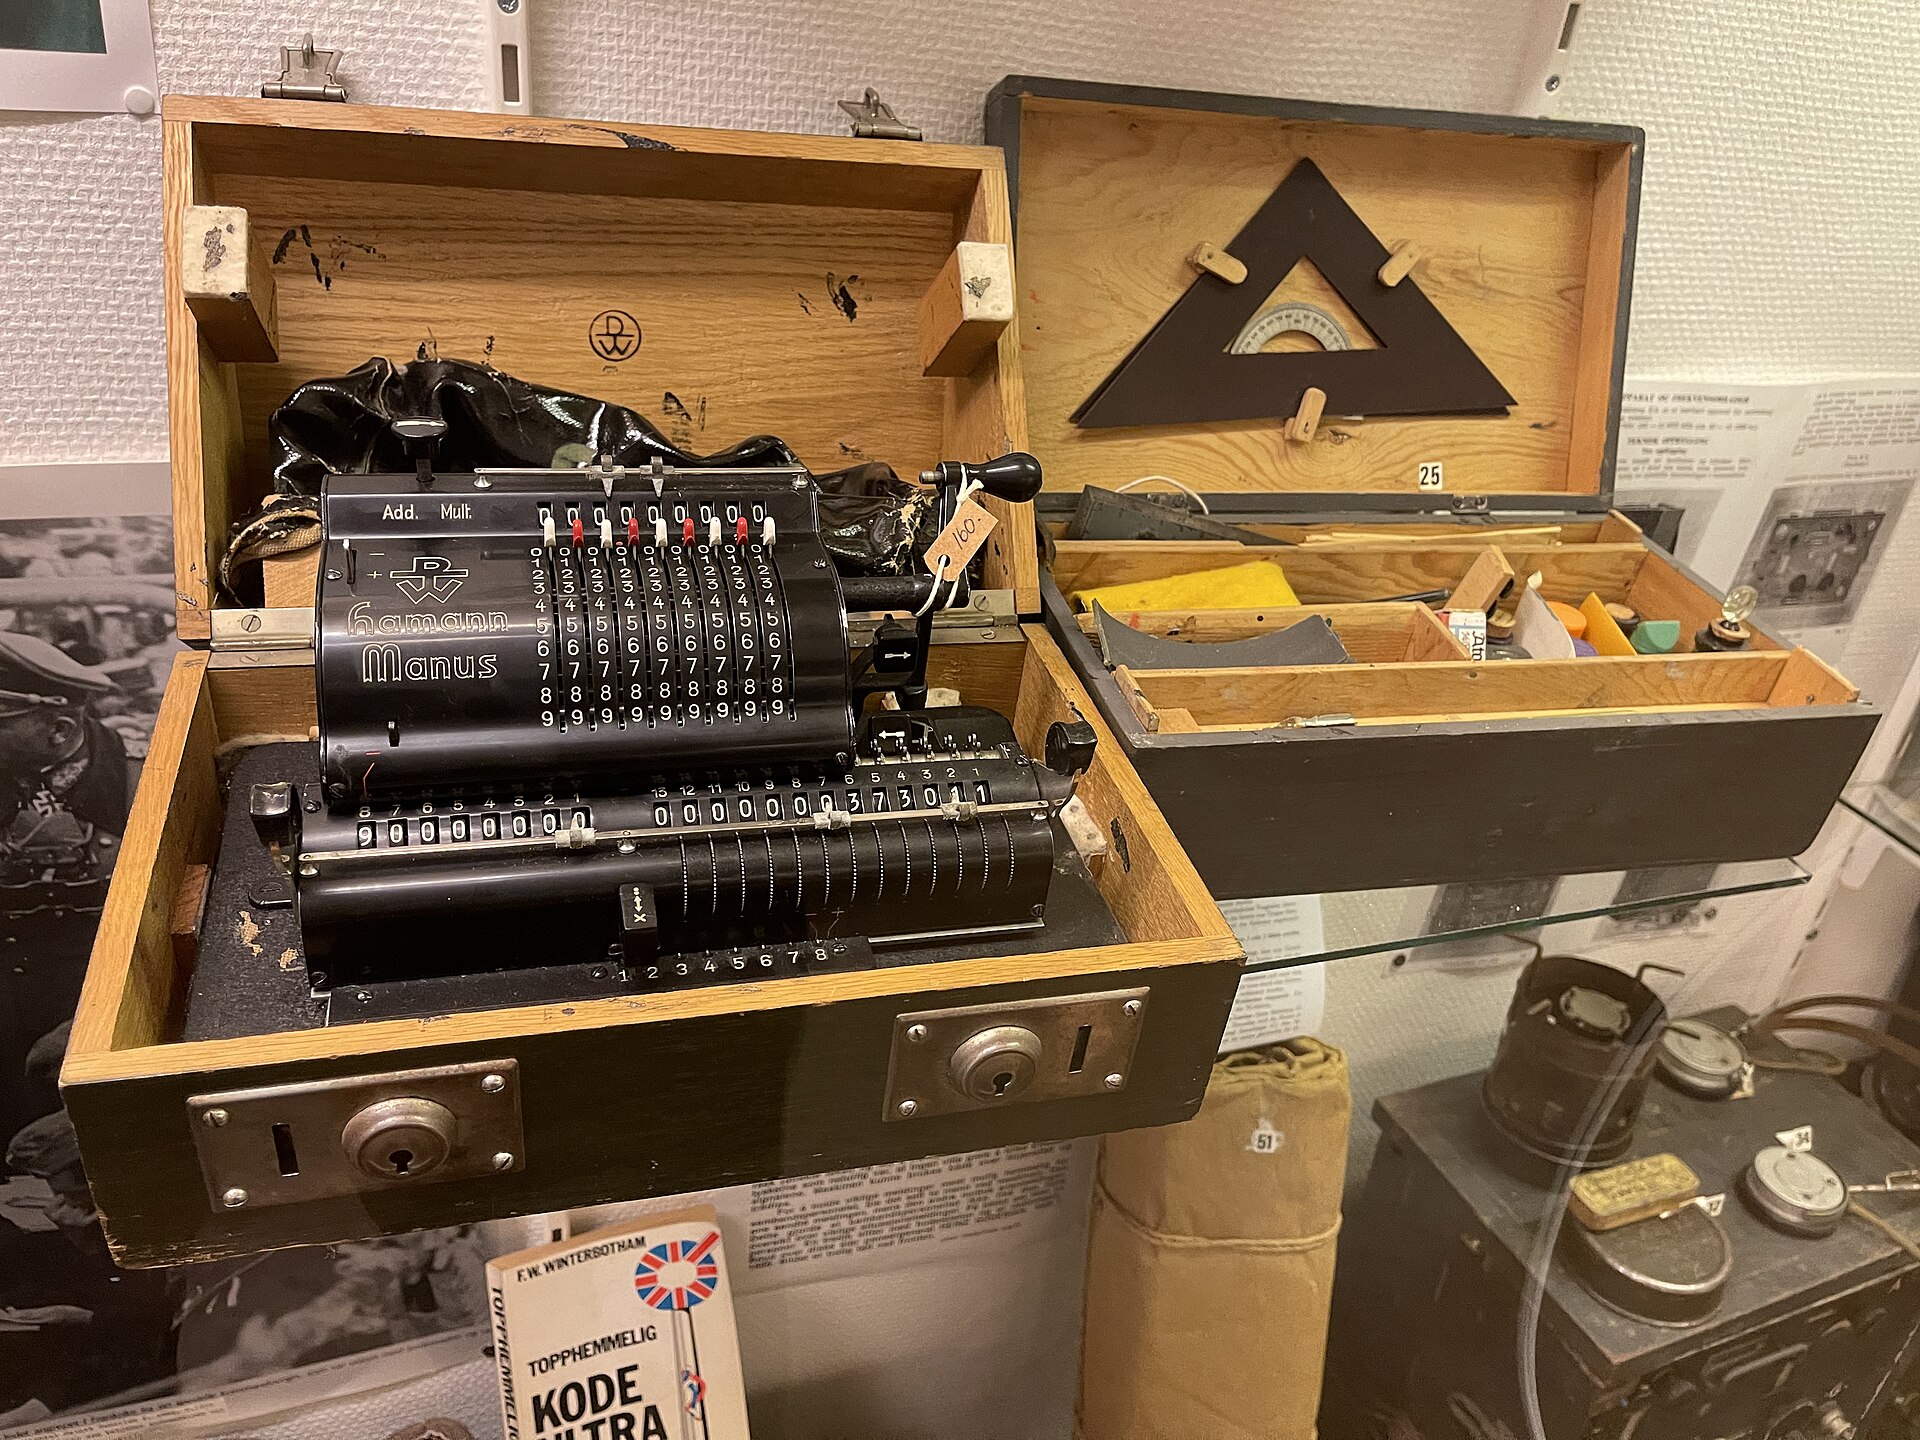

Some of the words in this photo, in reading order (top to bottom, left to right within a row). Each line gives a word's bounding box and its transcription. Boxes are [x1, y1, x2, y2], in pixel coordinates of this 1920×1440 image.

[1421, 466, 1439, 485] 25
[382, 504, 419, 520] Add.
[441, 504, 472, 520] Mult.
[753, 505, 763, 522] 0
[531, 548, 542, 556] 0
[560, 548, 570, 556] 0
[588, 547, 598, 555] 0
[616, 547, 627, 555] 0
[644, 546, 654, 554] 0
[671, 546, 681, 554] 0
[698, 545, 709, 553] 0
[725, 545, 735, 553] 0
[751, 545, 761, 553] 0
[531, 559, 539, 567] 1
[560, 558, 568, 567] 1
[589, 558, 597, 566] 1
[618, 557, 626, 566] 1
[645, 557, 654, 565] 1
[673, 556, 682, 564] 1
[701, 555, 709, 564] 1
[727, 555, 736, 563] 1
[754, 555, 762, 563] 1
[533, 570, 544, 579] 2
[562, 569, 573, 578] 2
[590, 569, 602, 578] 2
[620, 569, 631, 578] 2
[648, 568, 660, 577] 2
[676, 567, 687, 576] 2
[704, 566, 715, 575] 2
[731, 566, 742, 575] 2
[758, 566, 769, 574] 2
[533, 583, 545, 594] 3
[563, 582, 574, 593] 3
[592, 581, 603, 592] 3
[622, 581, 633, 592] 3
[651, 580, 662, 591] 3
[679, 580, 690, 590] 3
[708, 579, 718, 590] 3
[735, 578, 745, 589] 3
[761, 578, 772, 588] 3
[535, 599, 546, 612] 4
[565, 598, 576, 611] 4
[595, 597, 605, 610] 4
[624, 597, 635, 610] 4
[653, 596, 664, 609] 4
[682, 595, 692, 608] 4
[710, 594, 720, 607] 4
[738, 594, 748, 606] 4
[765, 593, 775, 606] 4
[567, 617, 578, 632] 5
[596, 616, 608, 631] 5
[627, 616, 638, 630] 5
[656, 615, 666, 630] 5
[684, 614, 695, 628] 5
[712, 613, 723, 628] 5
[740, 612, 751, 627] 5
[538, 640, 549, 656] 6
[567, 639, 579, 655] 6
[597, 638, 609, 654] 6
[628, 637, 639, 653] 6
[657, 636, 668, 652] 6
[685, 635, 697, 651] 6
[714, 634, 725, 650] 6
[742, 633, 753, 649] 6
[769, 632, 780, 648] 6
[362, 642, 497, 683] Manus
[539, 663, 549, 680] 7
[569, 662, 579, 679] 7
[599, 661, 609, 677] 7
[629, 660, 640, 676] 7
[658, 659, 668, 675] 7
[687, 658, 697, 674] 7
[716, 657, 726, 673] 7
[744, 656, 754, 671] 7
[771, 655, 781, 671] 7
[541, 687, 551, 704] 8
[571, 686, 581, 702] 8
[601, 685, 611, 701] 8
[631, 684, 641, 699] 8
[660, 682, 670, 698] 8
[689, 681, 699, 696] 8
[717, 680, 727, 695] 8
[745, 679, 755, 694] 8
[772, 678, 782, 693] 8
[542, 711, 553, 726] 9
[572, 710, 583, 725] 9
[602, 708, 612, 723] 9
[632, 707, 643, 722] 9
[660, 705, 671, 720] 9
[689, 704, 700, 719] 9
[717, 703, 728, 717] 9
[745, 701, 756, 716] 9
[772, 700, 783, 715] 9
[652, 787, 667, 798] 13
[680, 785, 695, 796] 12
[708, 783, 722, 794] 11
[735, 782, 750, 792] 10
[765, 780, 774, 790] 9
[792, 778, 801, 788] 8
[845, 775, 854, 784] 6
[871, 773, 881, 782] 5
[897, 771, 906, 780] 4
[922, 769, 931, 779] 3
[946, 768, 955, 777] 2
[973, 768, 979, 776] 1
[655, 807, 667, 825] 0
[683, 805, 696, 823] 0
[711, 803, 724, 821] 0
[739, 800, 752, 817] 0
[766, 799, 779, 817] 0
[794, 797, 807, 815] 0
[848, 793, 859, 811] 3
[873, 792, 884, 811] 7
[899, 790, 910, 807] 3
[924, 788, 936, 806] 0
[976, 785, 986, 803] 1
[358, 827, 372, 846] 9
[389, 824, 403, 843] 0
[421, 822, 435, 842] 0
[452, 820, 466, 840] 0
[483, 819, 496, 837] 0
[512, 816, 527, 836] 0
[542, 814, 556, 833] 0
[619, 971, 627, 982] 1
[647, 967, 659, 978] 2
[676, 964, 688, 975] 3
[704, 961, 715, 972] 4
[733, 957, 745, 969] 5
[760, 955, 772, 967] 6
[788, 952, 798, 963] 7
[815, 949, 827, 960] 8
[1257, 1135, 1272, 1150] 51
[543, 1236, 647, 1273] WINTERBOTHAM
[528, 1325, 656, 1376] TOPPHEMMELIG
[532, 1364, 642, 1434] KODE
[536, 1405, 668, 1440] TRA
